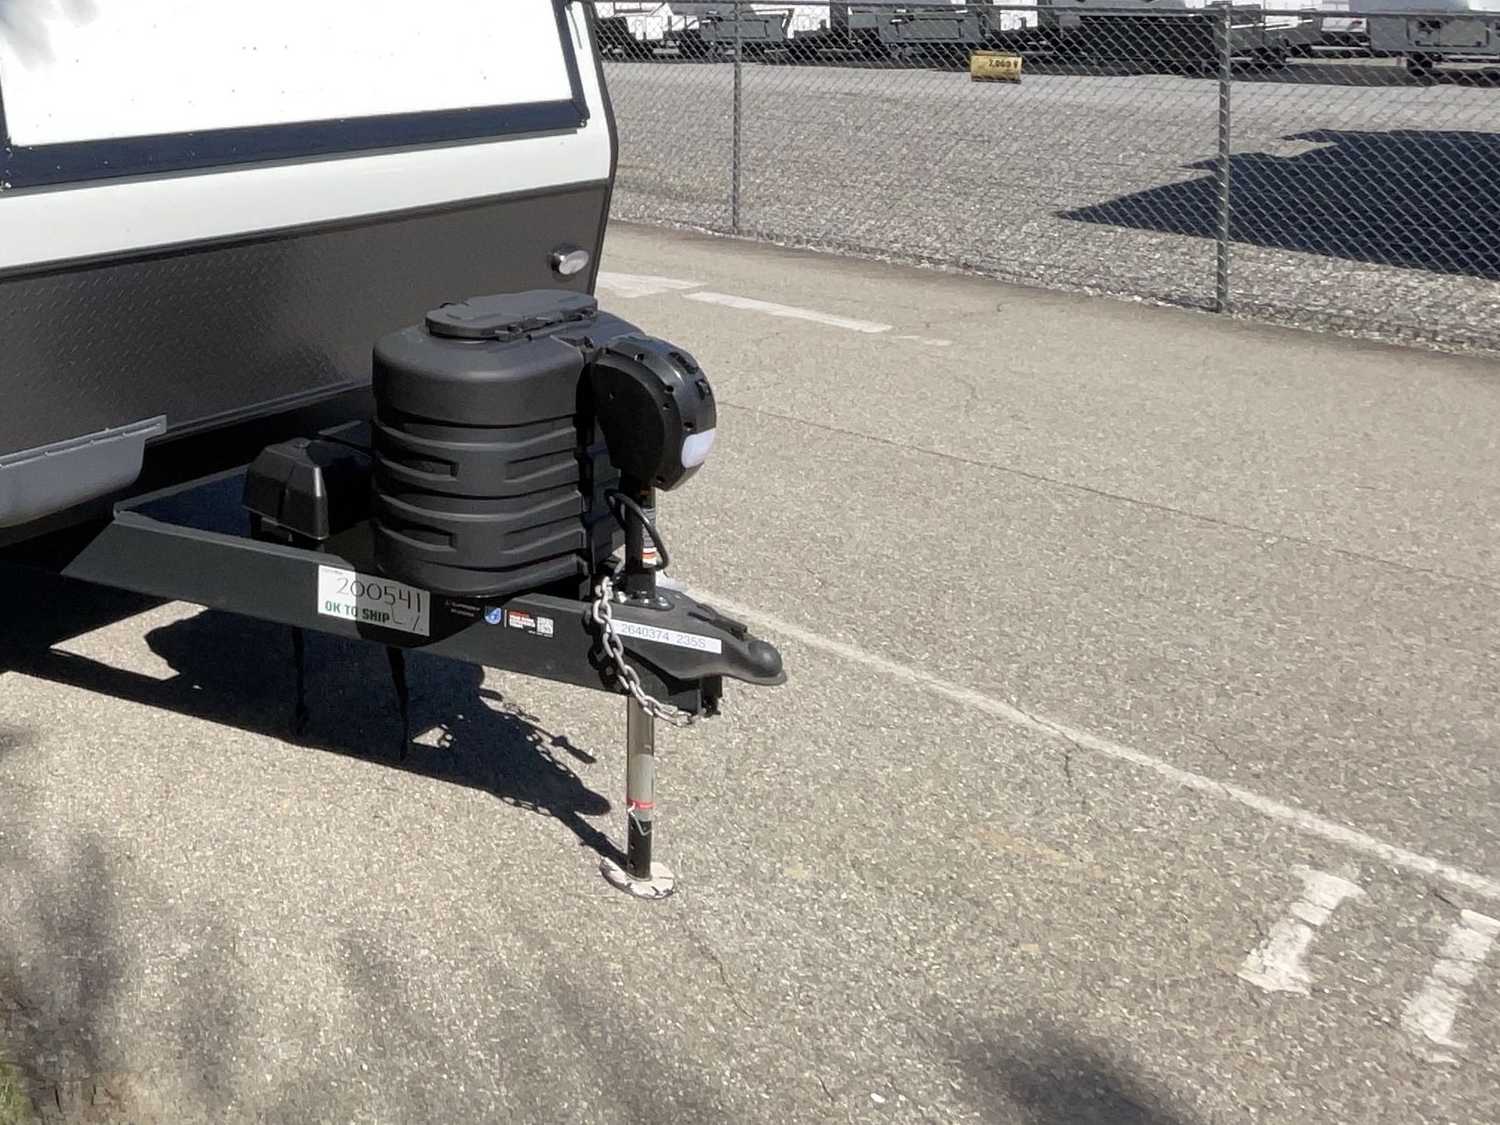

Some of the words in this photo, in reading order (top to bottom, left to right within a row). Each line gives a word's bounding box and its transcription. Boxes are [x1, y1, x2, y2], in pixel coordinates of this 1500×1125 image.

[336, 577, 420, 613] 200541
[325, 600, 341, 613] OK
[344, 604, 358, 617] TO
[362, 608, 390, 623] SHIP
[621, 623, 669, 642] 2640374
